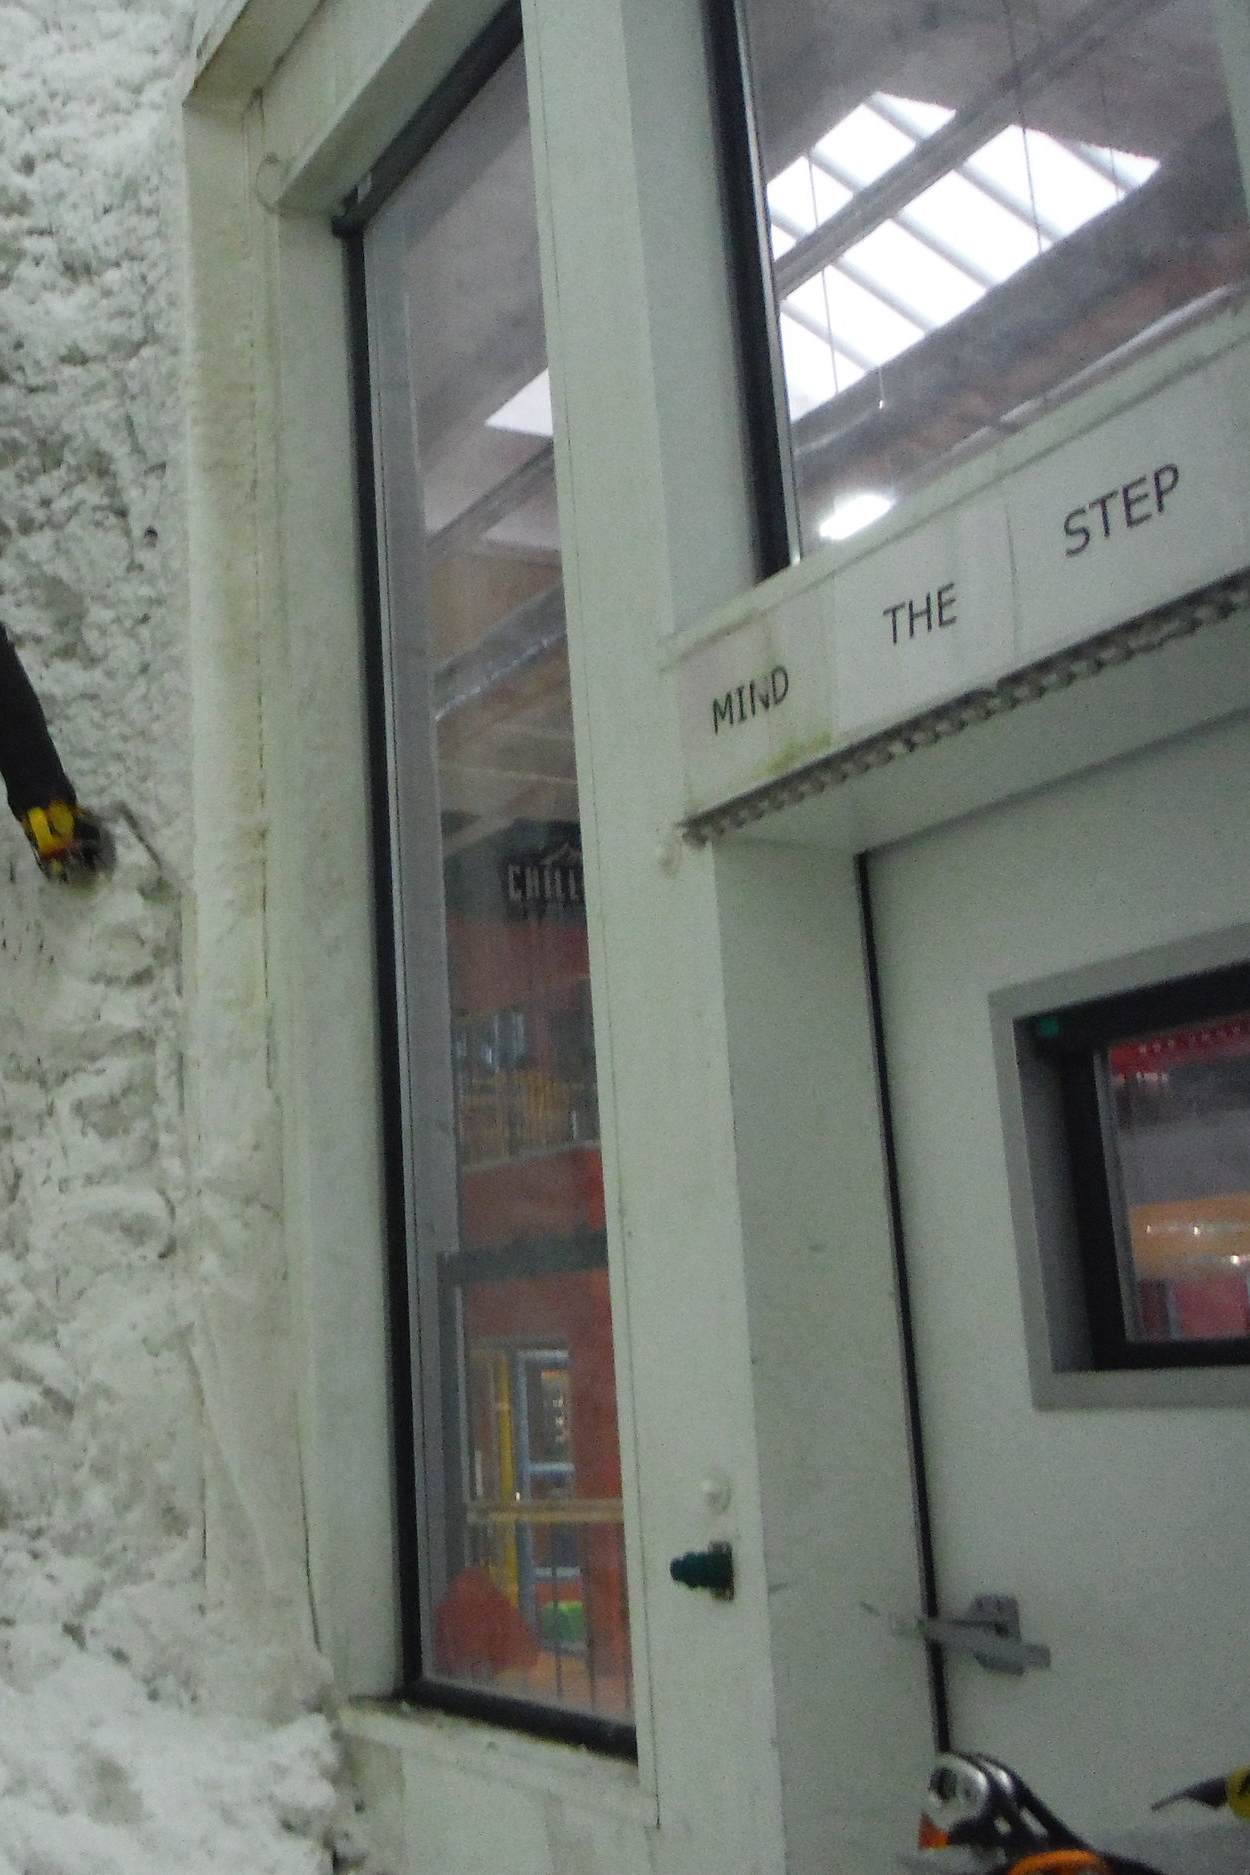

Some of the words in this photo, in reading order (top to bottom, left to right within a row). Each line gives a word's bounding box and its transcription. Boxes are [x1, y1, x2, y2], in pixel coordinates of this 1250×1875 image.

[713, 665, 789, 734] MIND
[882, 582, 957, 645] THE
[1064, 463, 1179, 557] STEP
